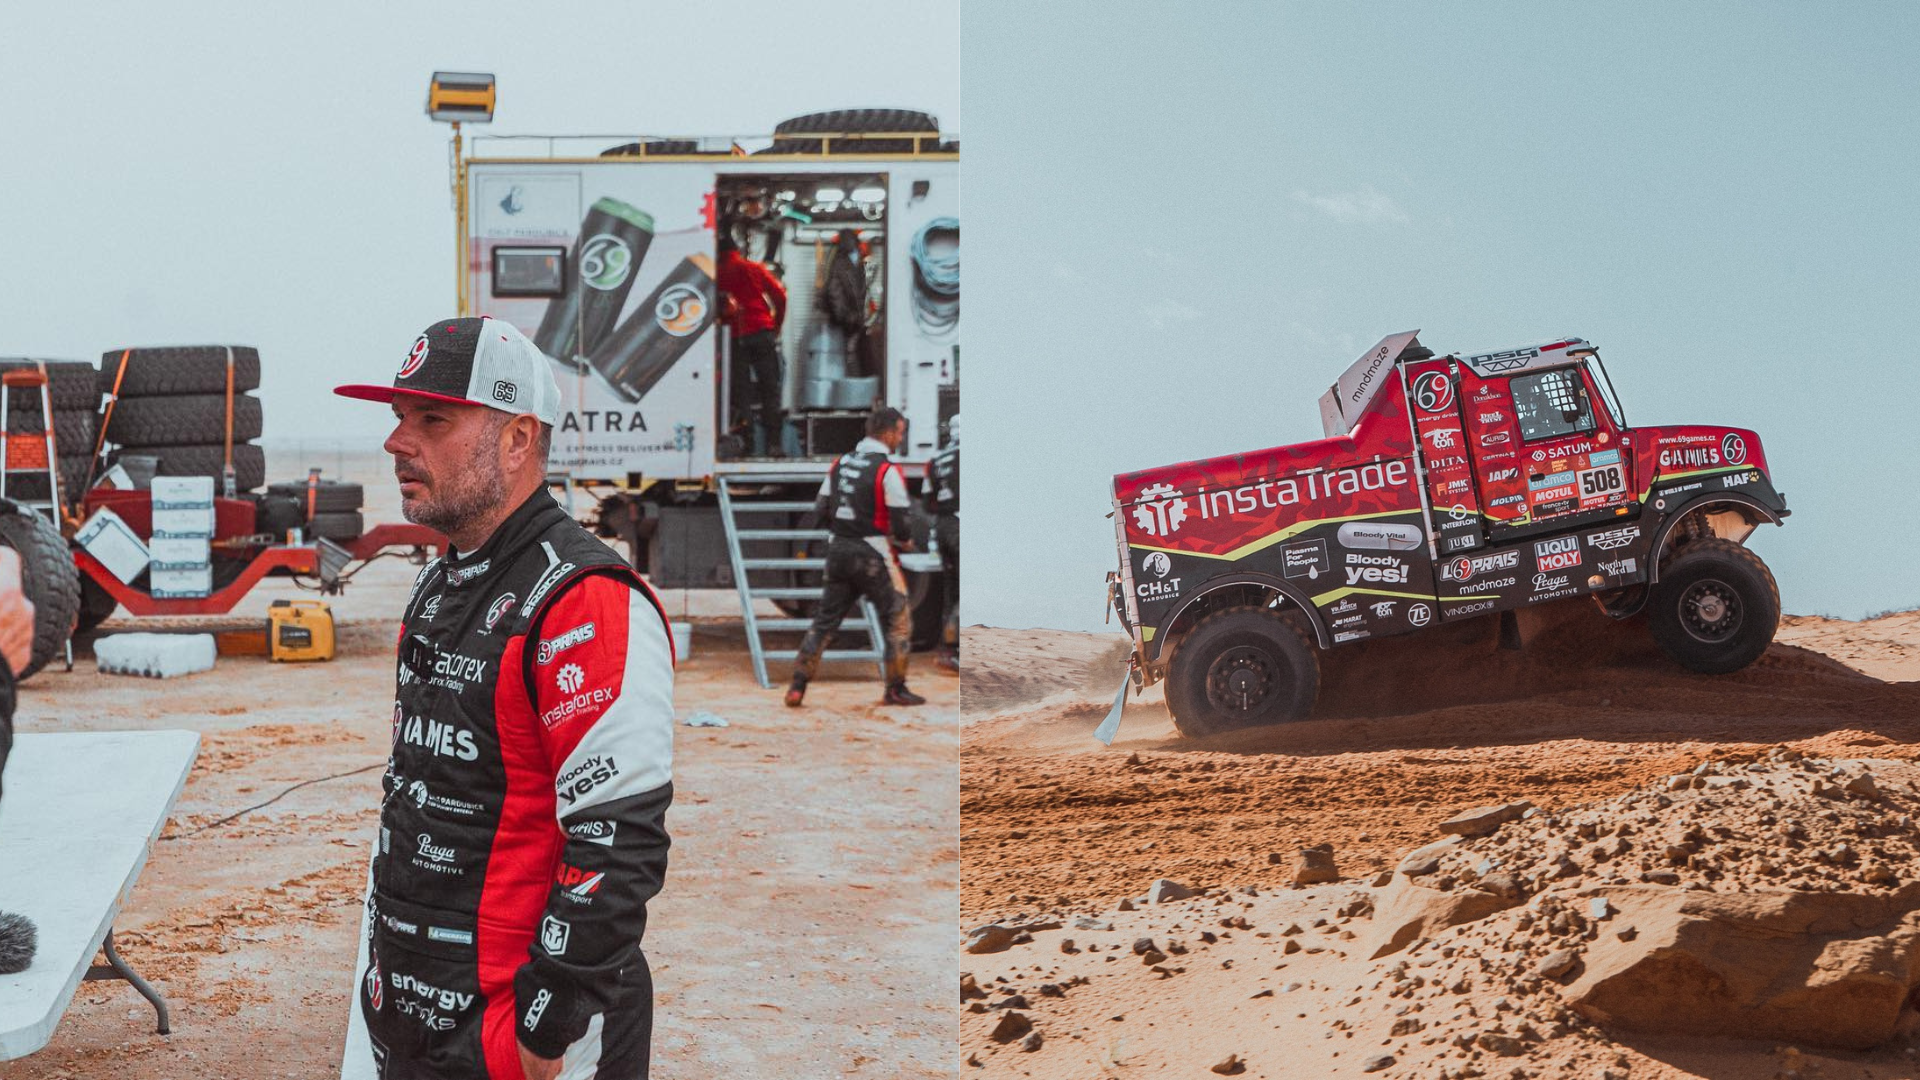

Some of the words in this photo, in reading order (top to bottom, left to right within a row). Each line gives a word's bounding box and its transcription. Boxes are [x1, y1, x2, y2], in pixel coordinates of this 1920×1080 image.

[1351, 346, 1389, 403] mindmaze
[493, 380, 517, 403] 69
[561, 411, 648, 432] ATRA
[1658, 435, 1716, 445] www.69games.cz
[1548, 442, 1592, 459] SATUM
[1592, 453, 1618, 463] aramco
[1659, 448, 1720, 467] GAMES
[1198, 454, 1408, 519] instaTrade
[1448, 480, 1468, 490] JMK
[1583, 468, 1620, 494] 508
[1722, 472, 1750, 488] HAF
[1490, 495, 1524, 506] MOLPIR
[1535, 487, 1573, 502] MOTUL
[1583, 496, 1606, 506] MOTUL
[1442, 518, 1477, 530] INTERFLON
[1353, 531, 1384, 539] Bloody
[1285, 546, 1319, 556] Plasma
[1536, 536, 1577, 556] LIQUI
[1287, 556, 1319, 567] People
[1345, 553, 1400, 568] Bloody
[1538, 553, 1580, 571] MOLY
[1598, 560, 1622, 572] North
[1344, 564, 1409, 585] yes!
[1608, 566, 1626, 577] Med
[1137, 577, 1181, 597] CH&T
[1459, 577, 1516, 595] mindmaze
[1532, 573, 1569, 592] Praga
[1142, 592, 1180, 602] PARDUBICE
[1528, 587, 1578, 602] AUTOMOTIVE
[1412, 607, 1427, 623] ZF
[1445, 603, 1487, 617] VINOBOX
[1343, 615, 1363, 624] MARAT
[541, 686, 613, 726] instaforex
[556, 755, 602, 789] Bloody
[558, 757, 620, 805] yes!
[417, 833, 455, 862] Praga
[412, 858, 464, 875] AUTOMOTIVE
[391, 972, 475, 1012] energy
[395, 997, 457, 1031] drinks
